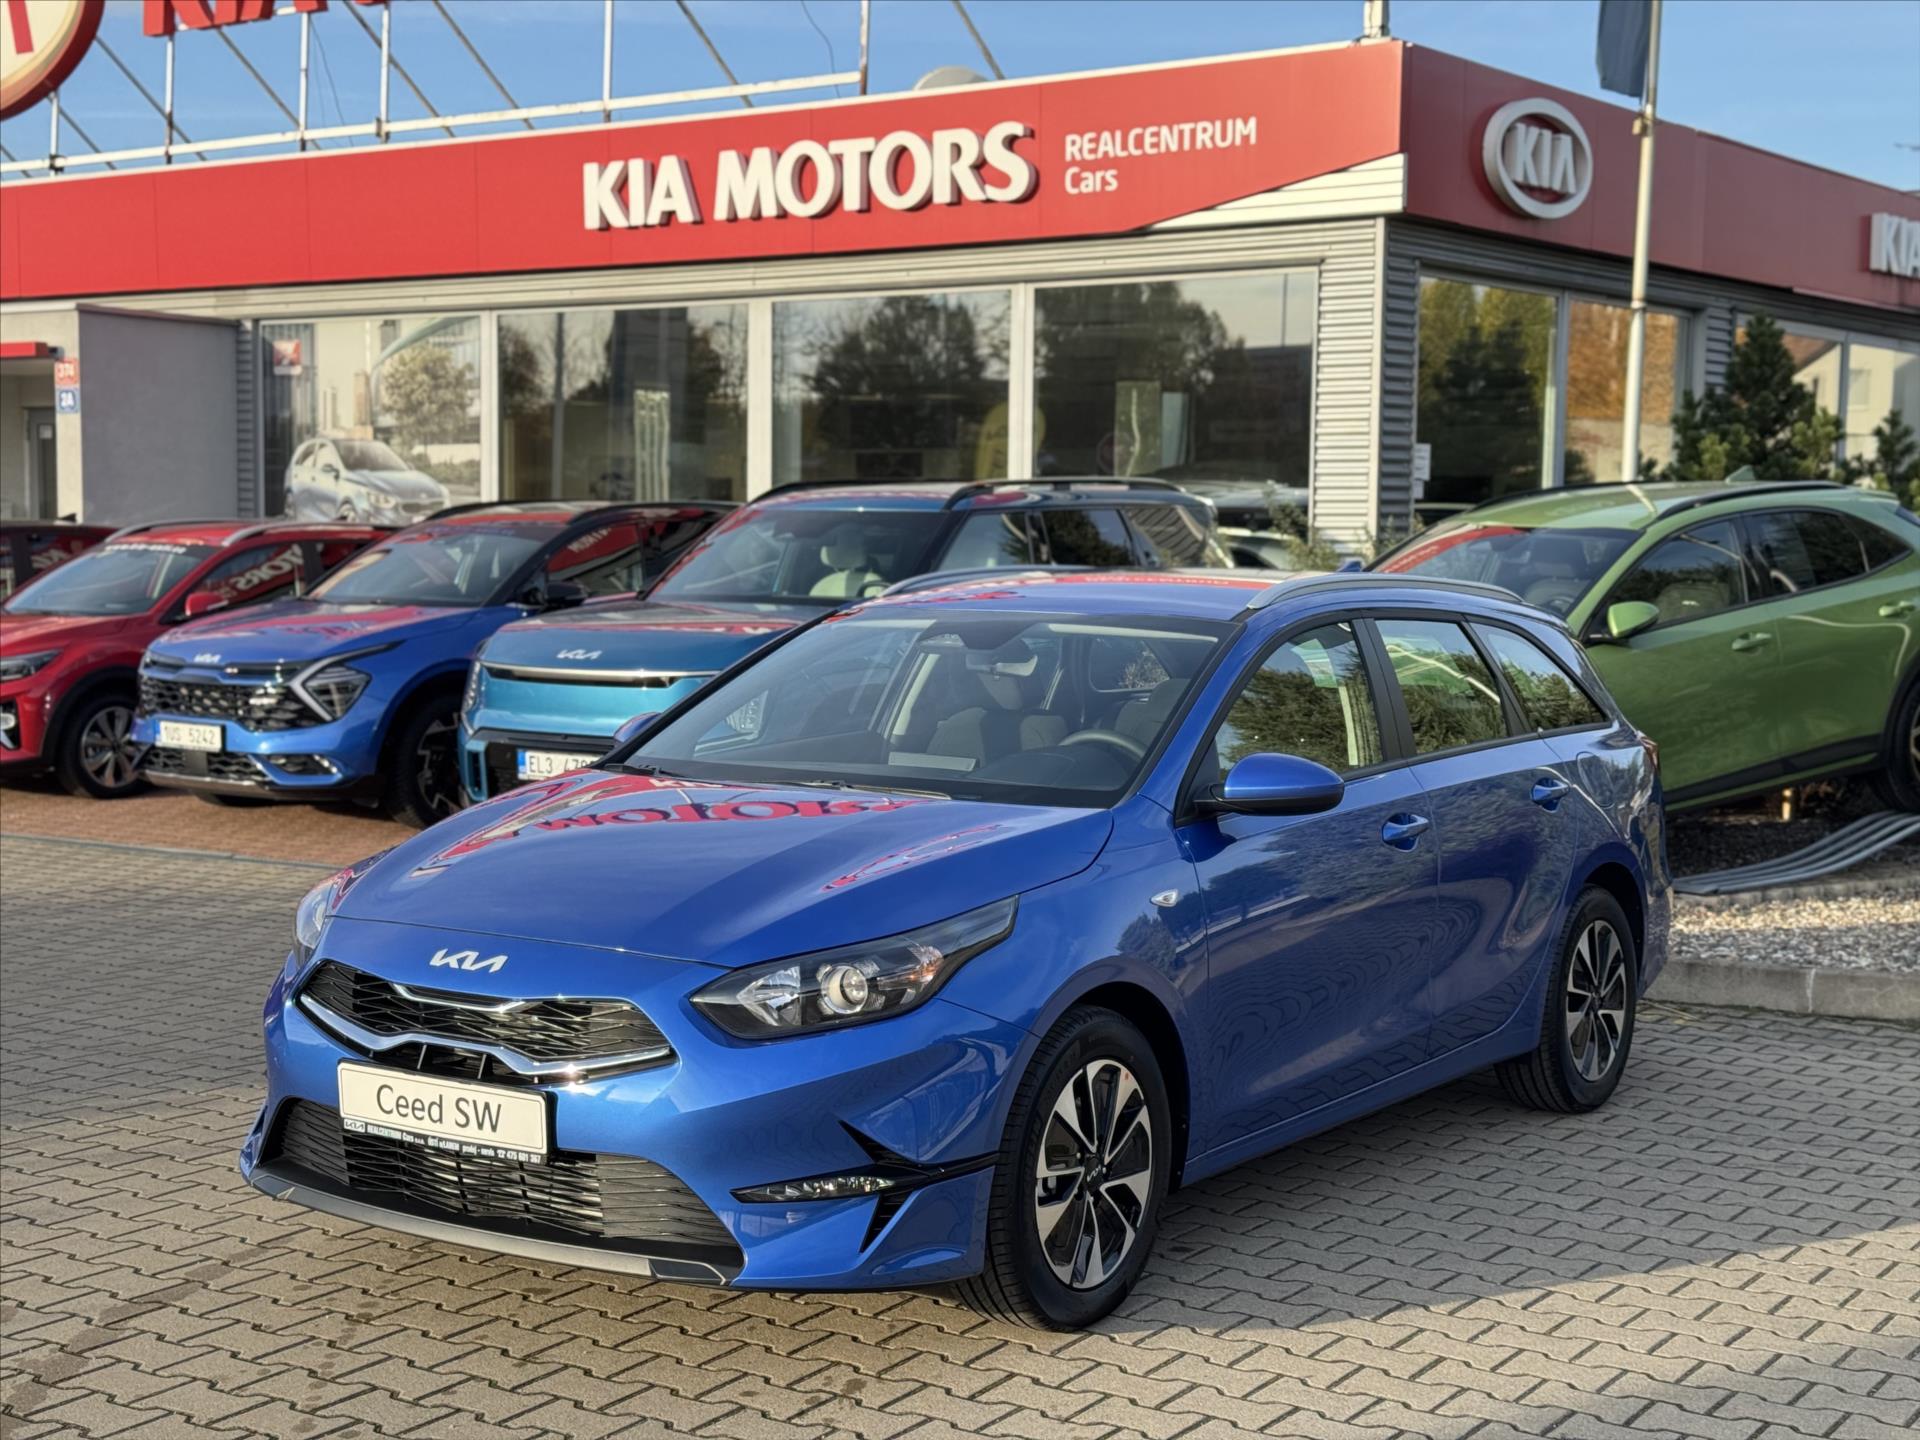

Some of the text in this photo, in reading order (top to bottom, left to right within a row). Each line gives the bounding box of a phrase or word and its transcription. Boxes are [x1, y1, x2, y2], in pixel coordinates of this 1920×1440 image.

[1064, 116, 1257, 162] REALCENTRUM
[1508, 121, 1578, 194] KIA
[583, 120, 1032, 230] KIA MOTORS
[1064, 166, 1119, 195] Cars
[528, 755, 553, 774] EL3
[429, 948, 509, 973] KIA
[376, 1083, 502, 1134] Ceed SW
